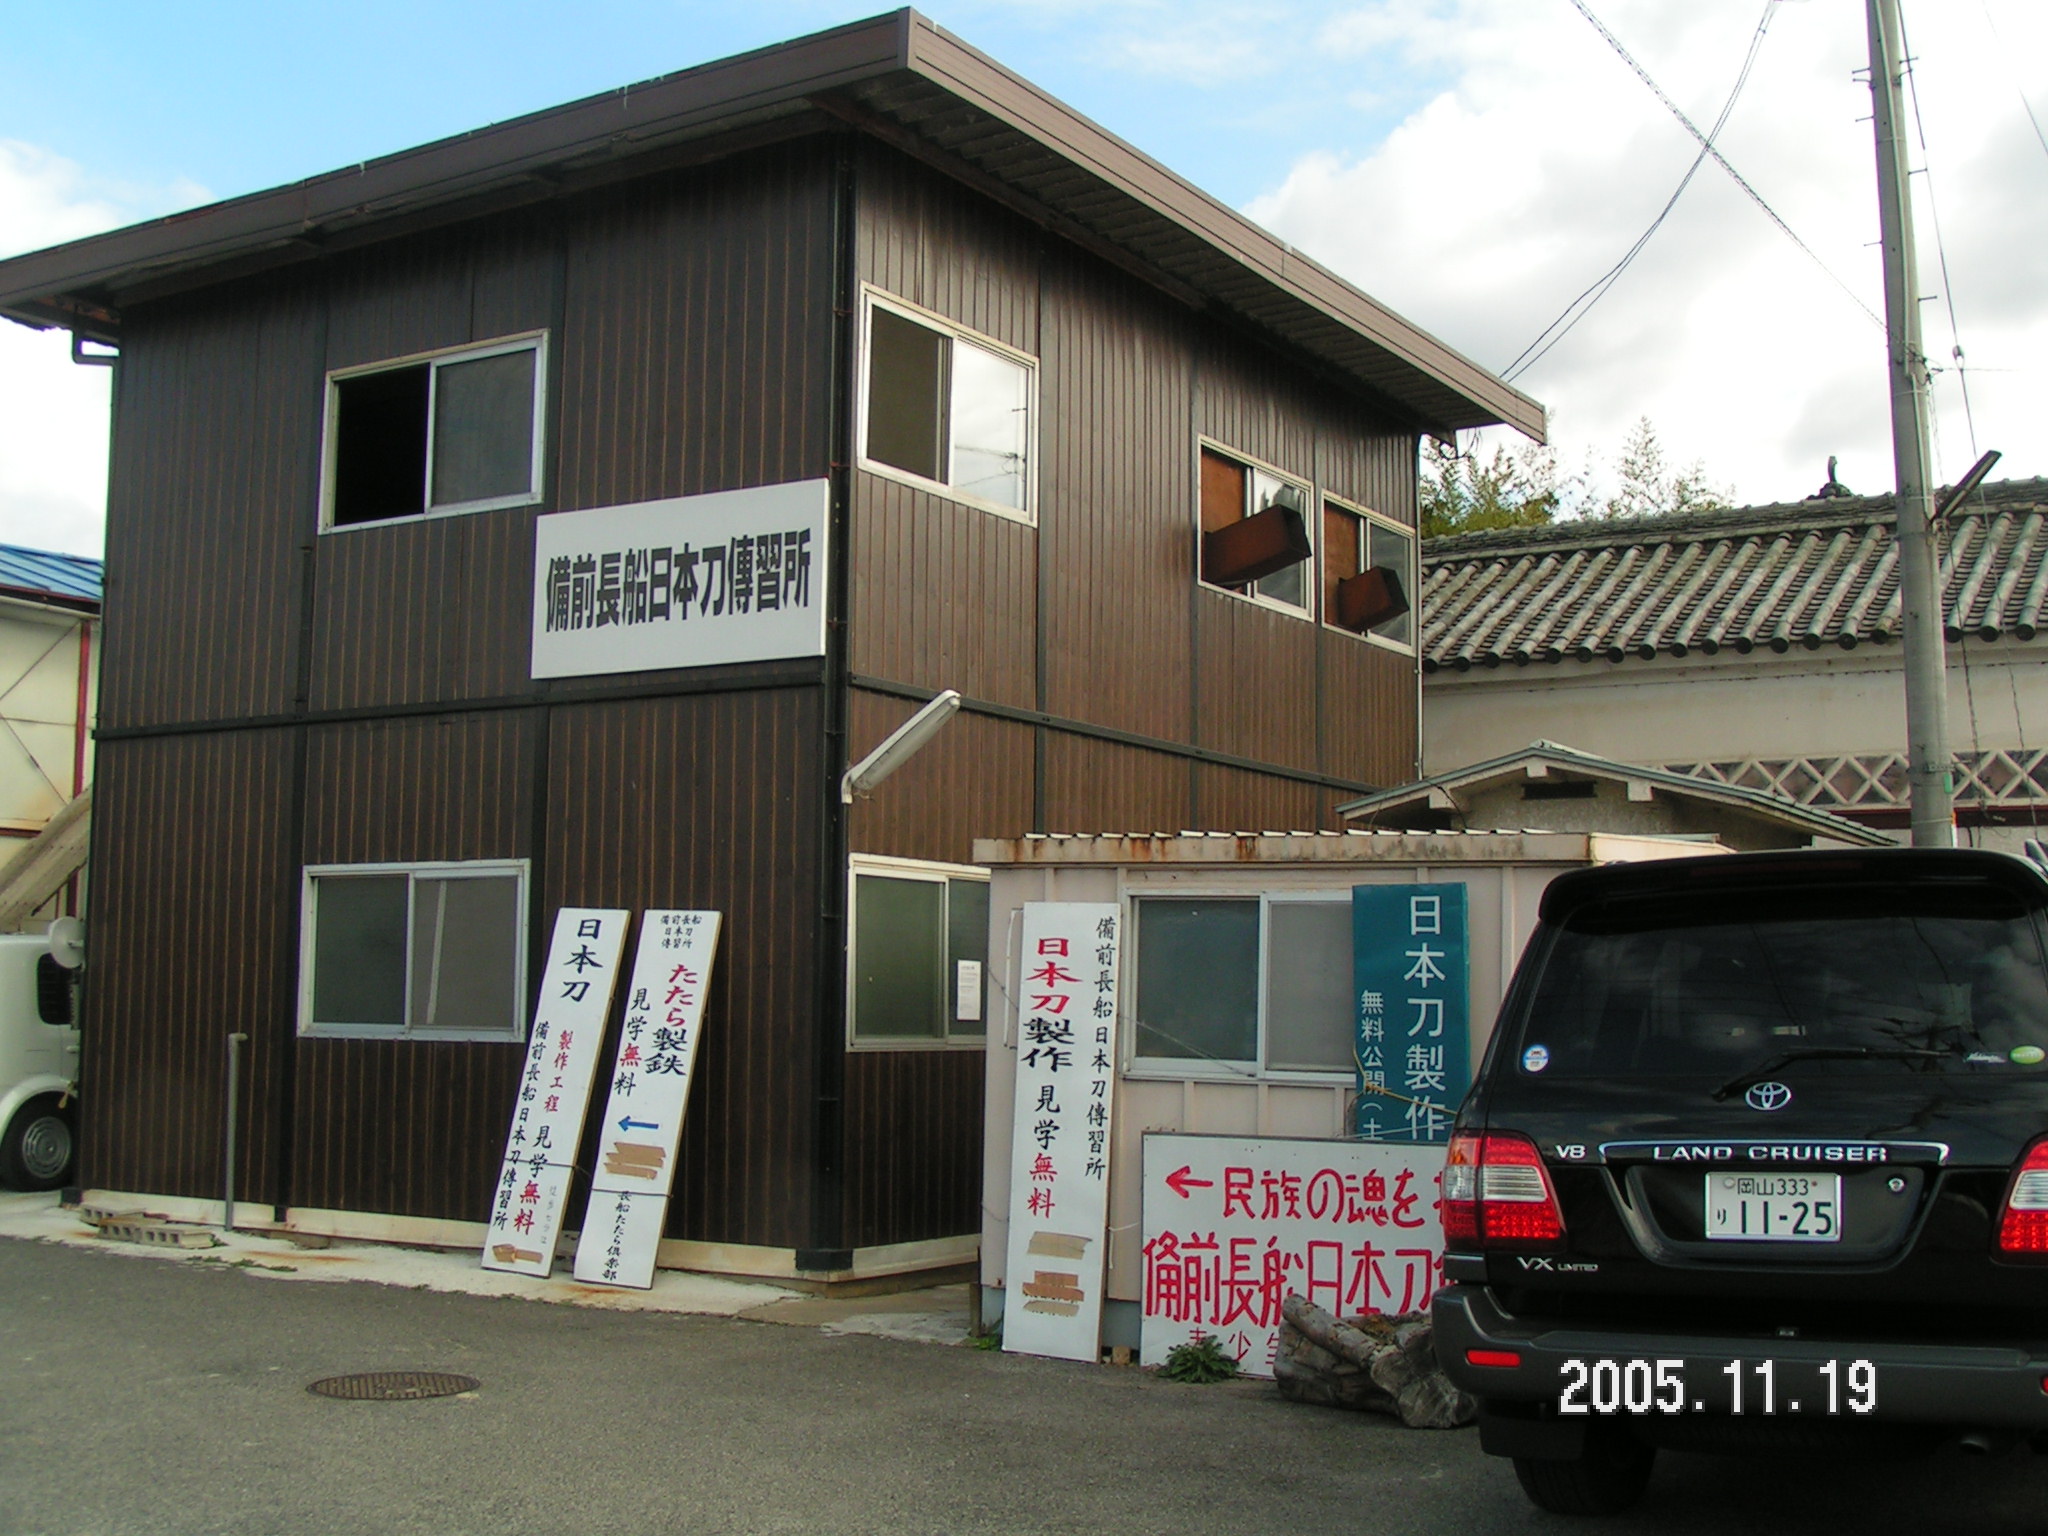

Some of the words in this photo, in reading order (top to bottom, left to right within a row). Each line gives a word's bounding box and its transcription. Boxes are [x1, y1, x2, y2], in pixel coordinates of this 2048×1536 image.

[546, 527, 811, 632] 備前長船日本刀傳習所
[560, 919, 604, 1002] 日本刀
[1020, 937, 1084, 1073] 日本刀製作
[614, 988, 651, 1097] 見学無料
[644, 964, 698, 1076] たたら製鉄
[1084, 916, 1116, 1181] 備前長船日本刀傳習所
[1403, 895, 1446, 1141] 日本刀製作
[544, 1030, 574, 1112] 製作工程
[514, 1125, 552, 1235] 見学無料
[1026, 1084, 1061, 1218] 見学無料
[1223, 1166, 1444, 1227] 民族の魂を
[1555, 1144, 1587, 1159] V8
[1653, 1144, 1733, 1161] LAND
[1748, 1144, 1887, 1162] CRUISER
[1516, 1256, 1554, 1271] VX
[1557, 1263, 1599, 1272] LIMITED
[1741, 1200, 1832, 1235] 11-25
[1143, 1230, 1446, 1328] 備前長船日本刀
